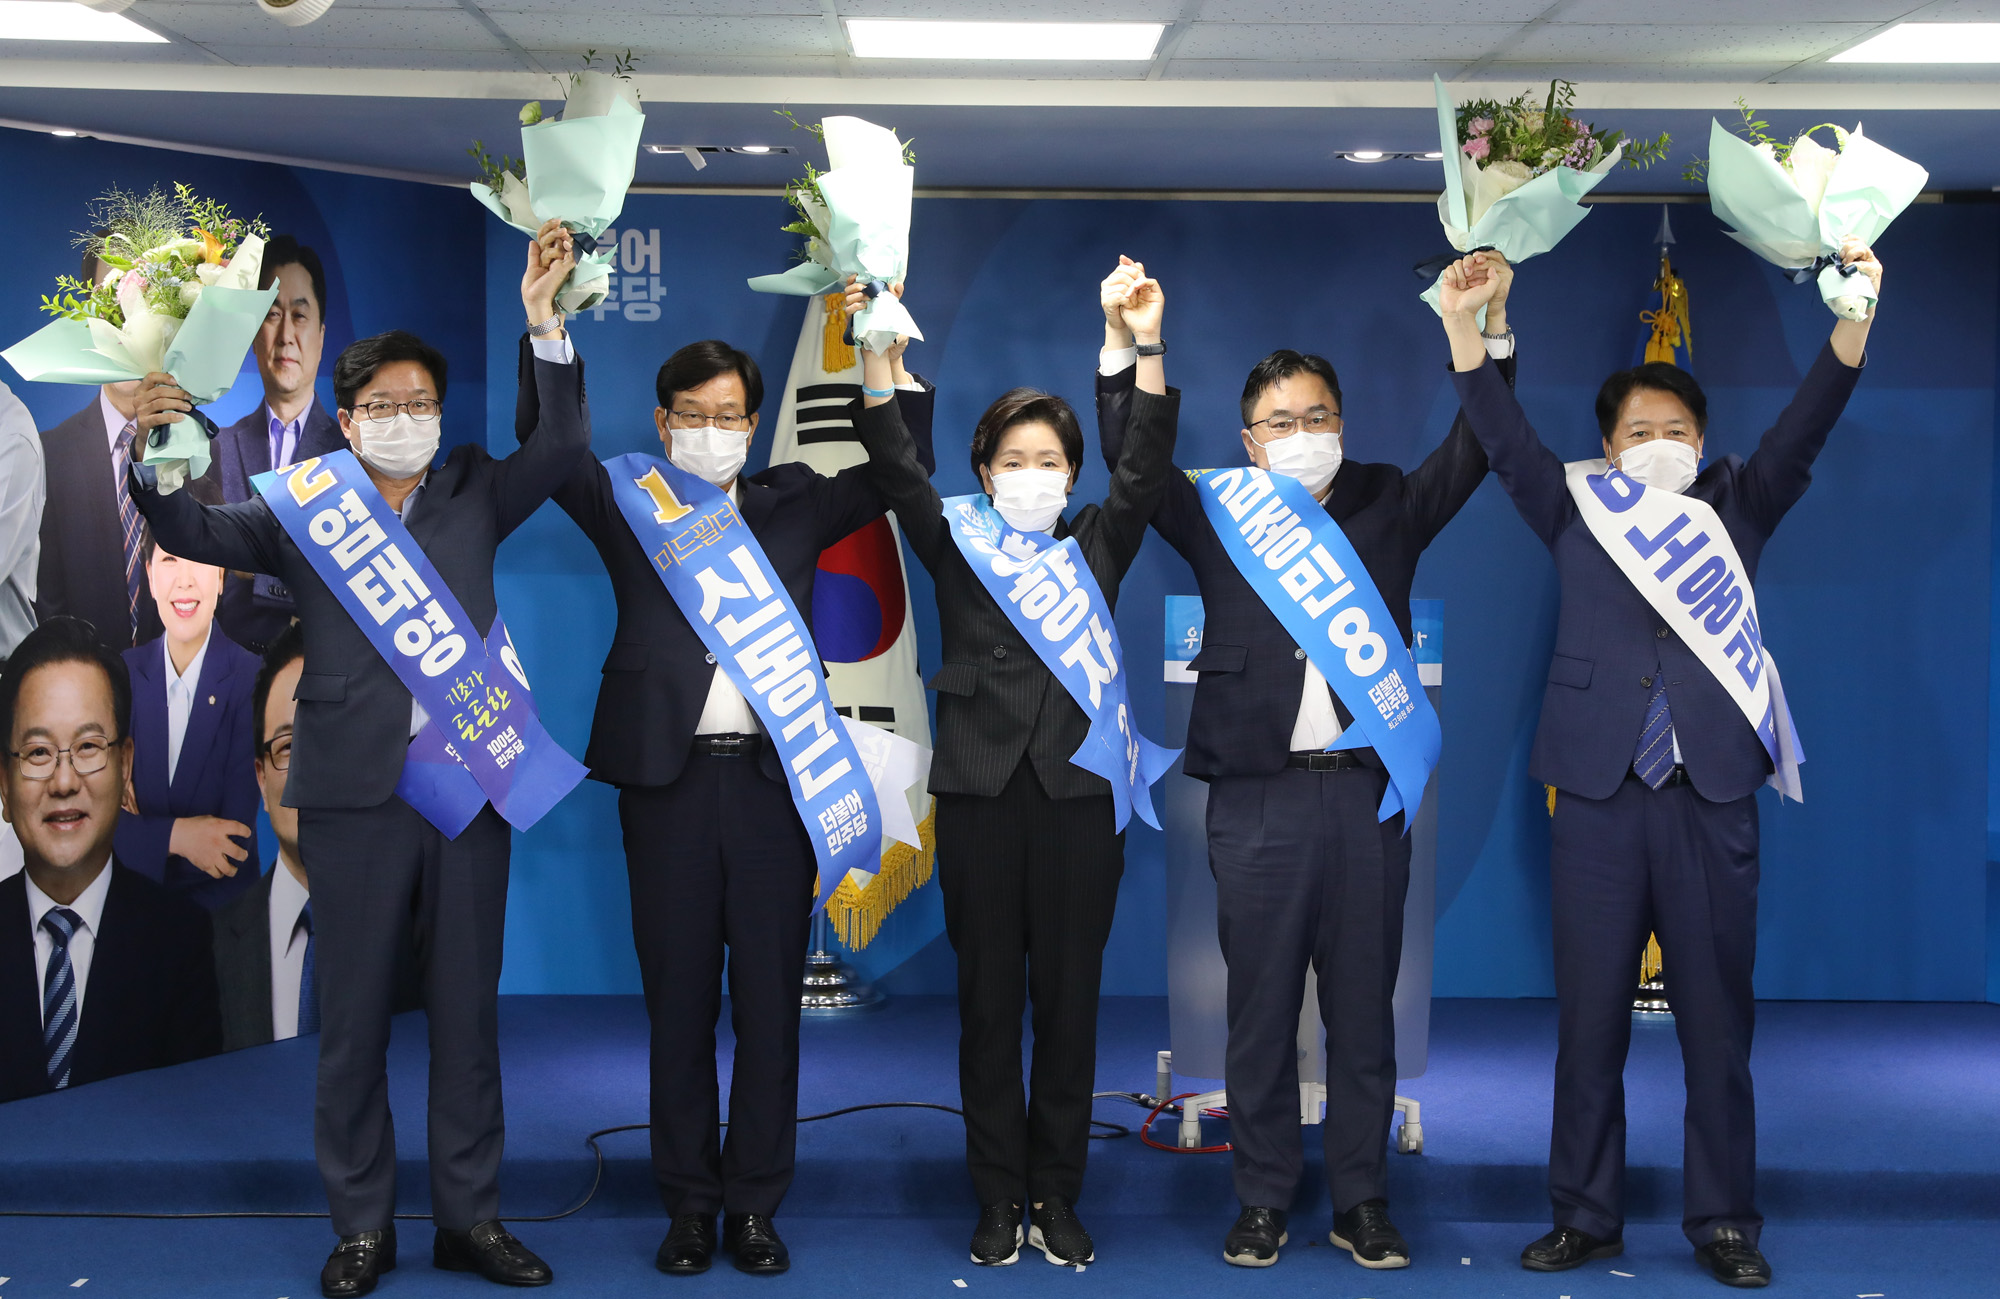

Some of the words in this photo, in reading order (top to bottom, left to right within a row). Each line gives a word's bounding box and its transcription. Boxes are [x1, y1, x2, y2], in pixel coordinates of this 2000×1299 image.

[276, 456, 338, 508] 2
[633, 465, 694, 526] 1
[654, 502, 742, 572] 미드필더
[1209, 467, 1356, 620] 김종민
[308, 488, 466, 677] 염태영
[1624, 512, 1764, 692] 노웅래
[1327, 606, 1388, 677] 8
[445, 670, 484, 705] 기초가
[694, 545, 852, 802] 신동근
[1367, 668, 1402, 706] 더불어
[1377, 684, 1409, 721] 민주당
[487, 725, 518, 757] 100년
[496, 738, 525, 769] 민주당
[818, 789, 863, 832] 더불어
[826, 810, 868, 857] 민주당
